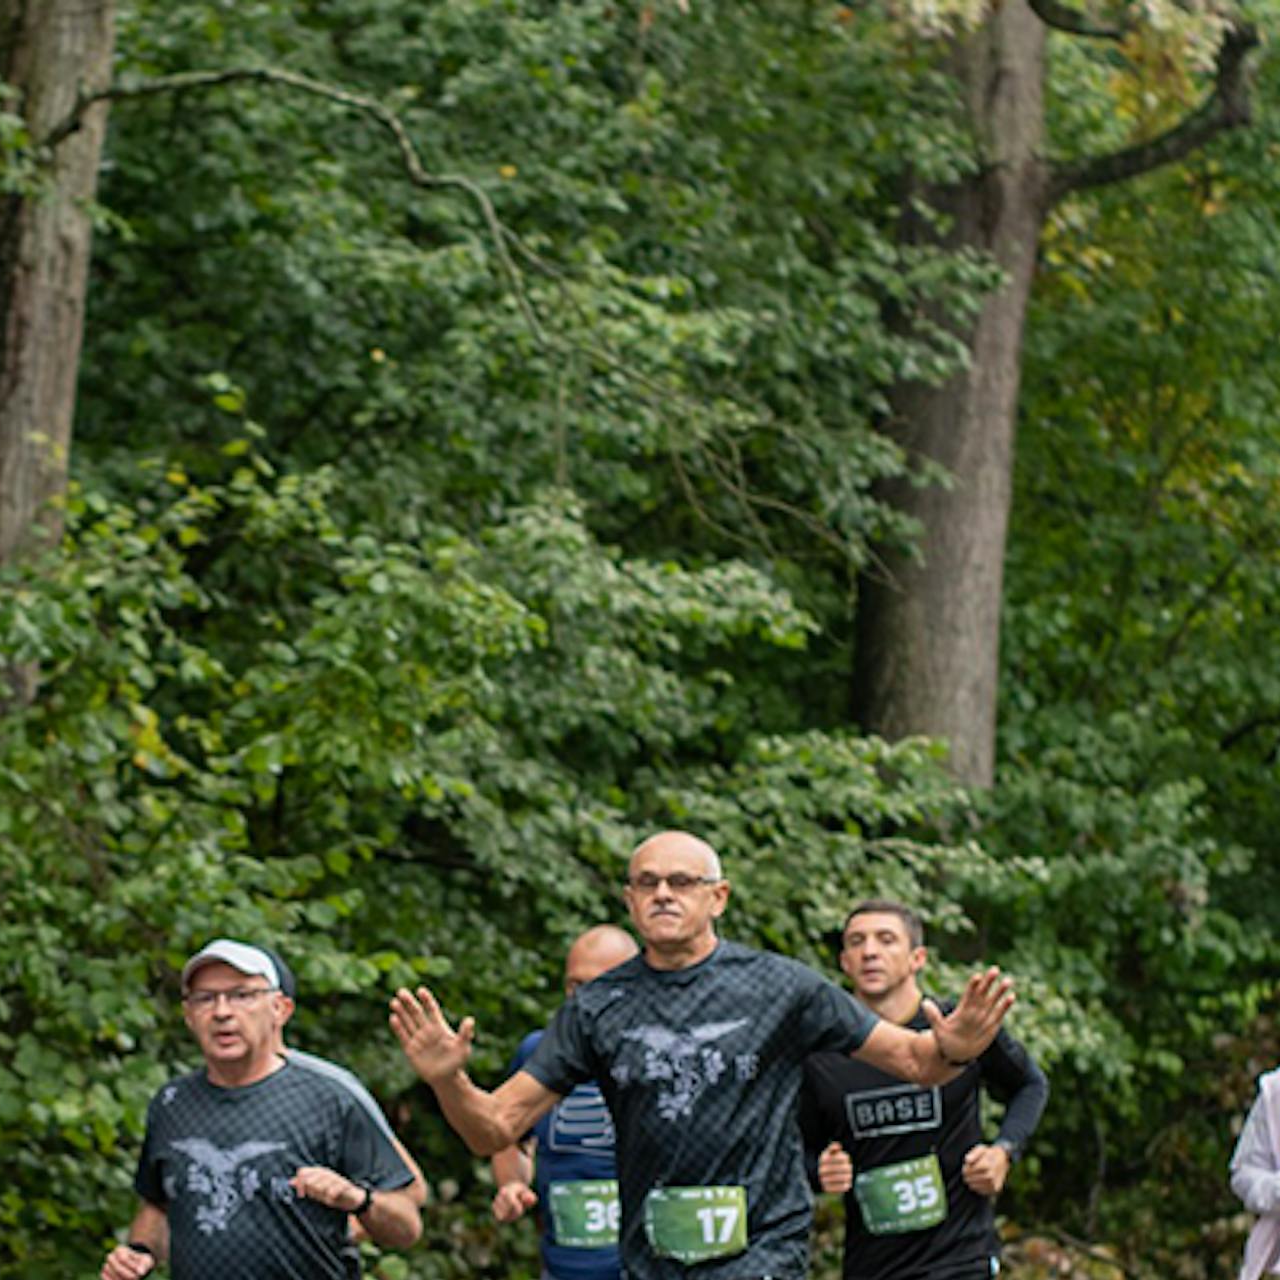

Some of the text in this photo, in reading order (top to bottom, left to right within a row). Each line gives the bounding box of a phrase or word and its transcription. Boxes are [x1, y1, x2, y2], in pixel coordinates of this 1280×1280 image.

[855, 1092, 933, 1128] BASE
[892, 1174, 939, 1214] 35
[697, 1206, 738, 1245] 17
